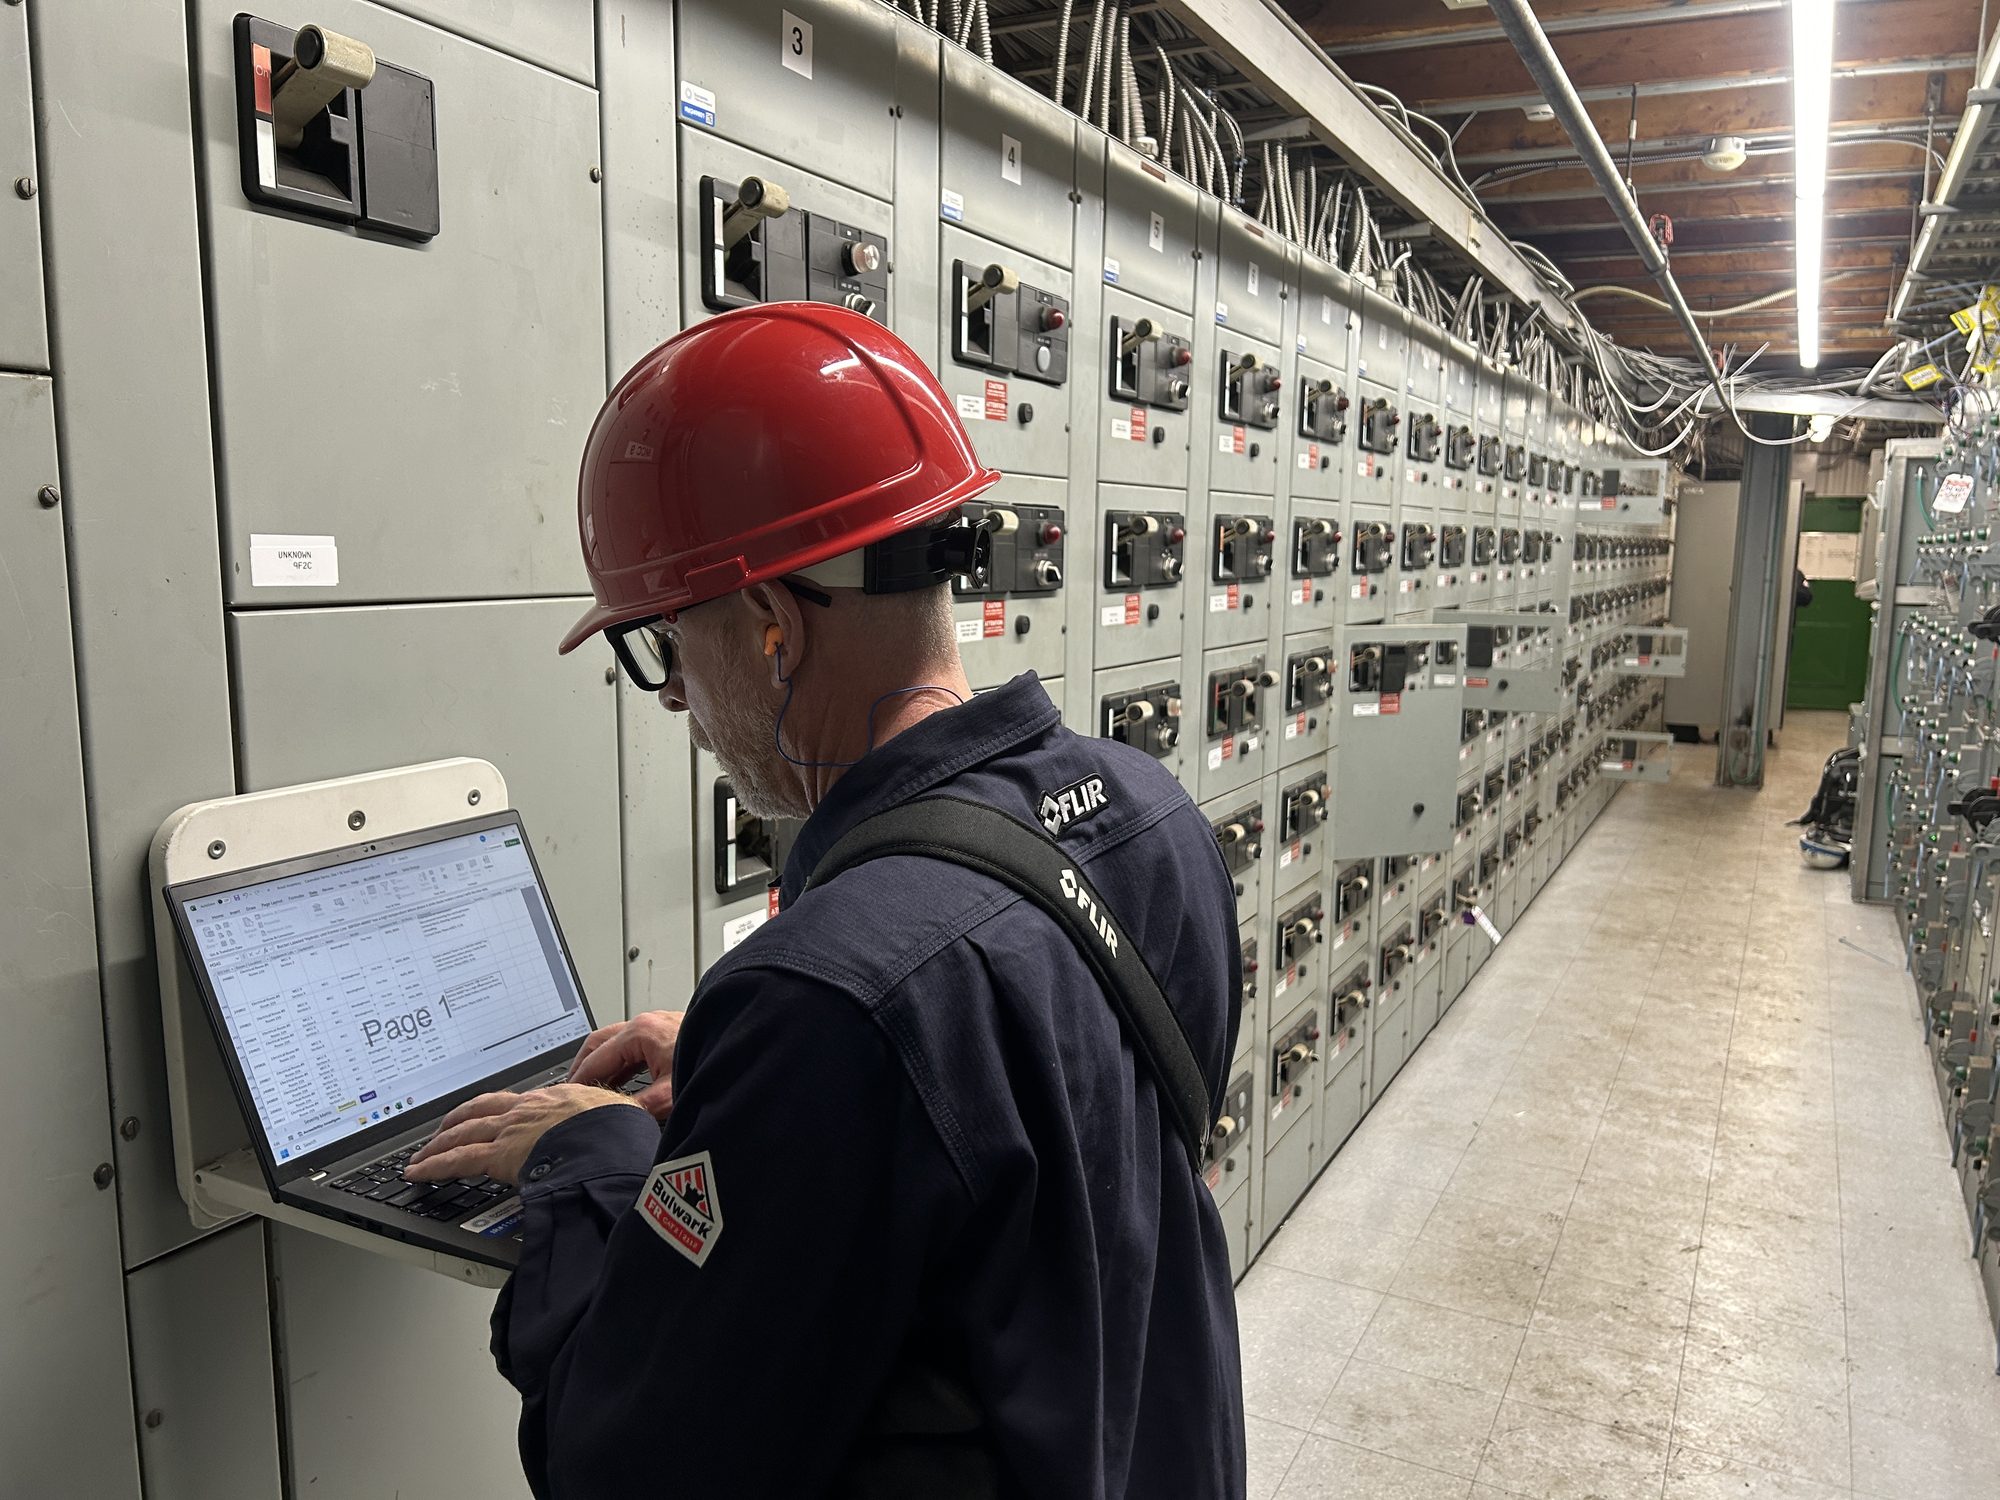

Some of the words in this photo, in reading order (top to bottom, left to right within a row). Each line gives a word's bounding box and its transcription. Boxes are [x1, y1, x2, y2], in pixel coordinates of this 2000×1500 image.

[792, 26, 803, 55] 3
[255, 64, 269, 78] On
[1008, 146, 1016, 168] 4
[278, 551, 312, 559] UNKNOWN
[1057, 779, 1108, 823] FLIR
[1077, 886, 1118, 959] FLIR
[362, 1008, 433, 1048] Page
[438, 994, 452, 1019] 1
[648, 1198, 662, 1219] FR
[652, 1178, 711, 1240] Bulwark
